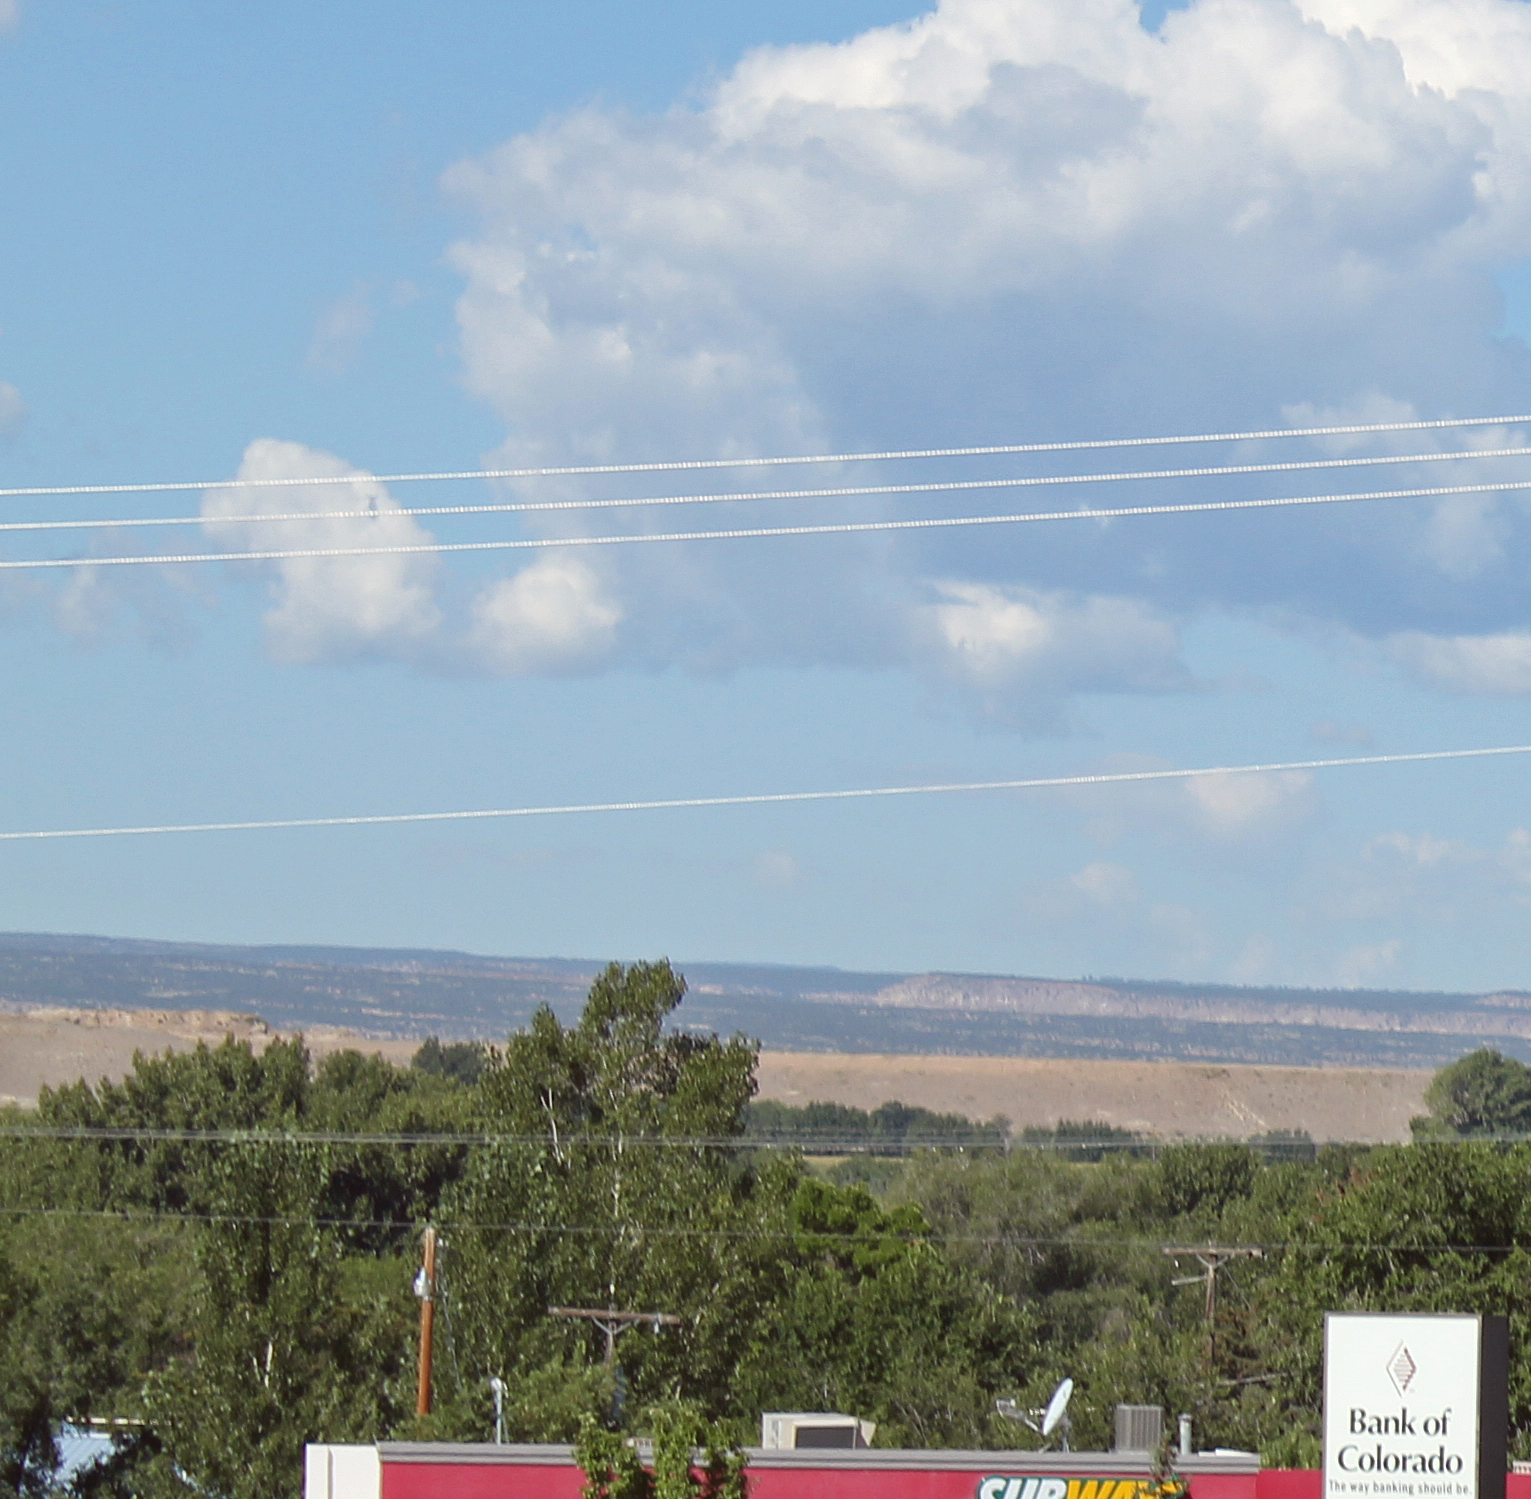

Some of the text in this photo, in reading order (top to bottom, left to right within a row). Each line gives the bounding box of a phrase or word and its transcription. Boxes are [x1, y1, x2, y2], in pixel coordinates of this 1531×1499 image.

[1349, 1406, 1452, 1437] Bank of
[1337, 1443, 1463, 1474] Colorado
[1329, 1480, 1347, 1493] The
[1349, 1482, 1370, 1495] way
[1373, 1481, 1415, 1495] banking
[1418, 1482, 1453, 1495] should
